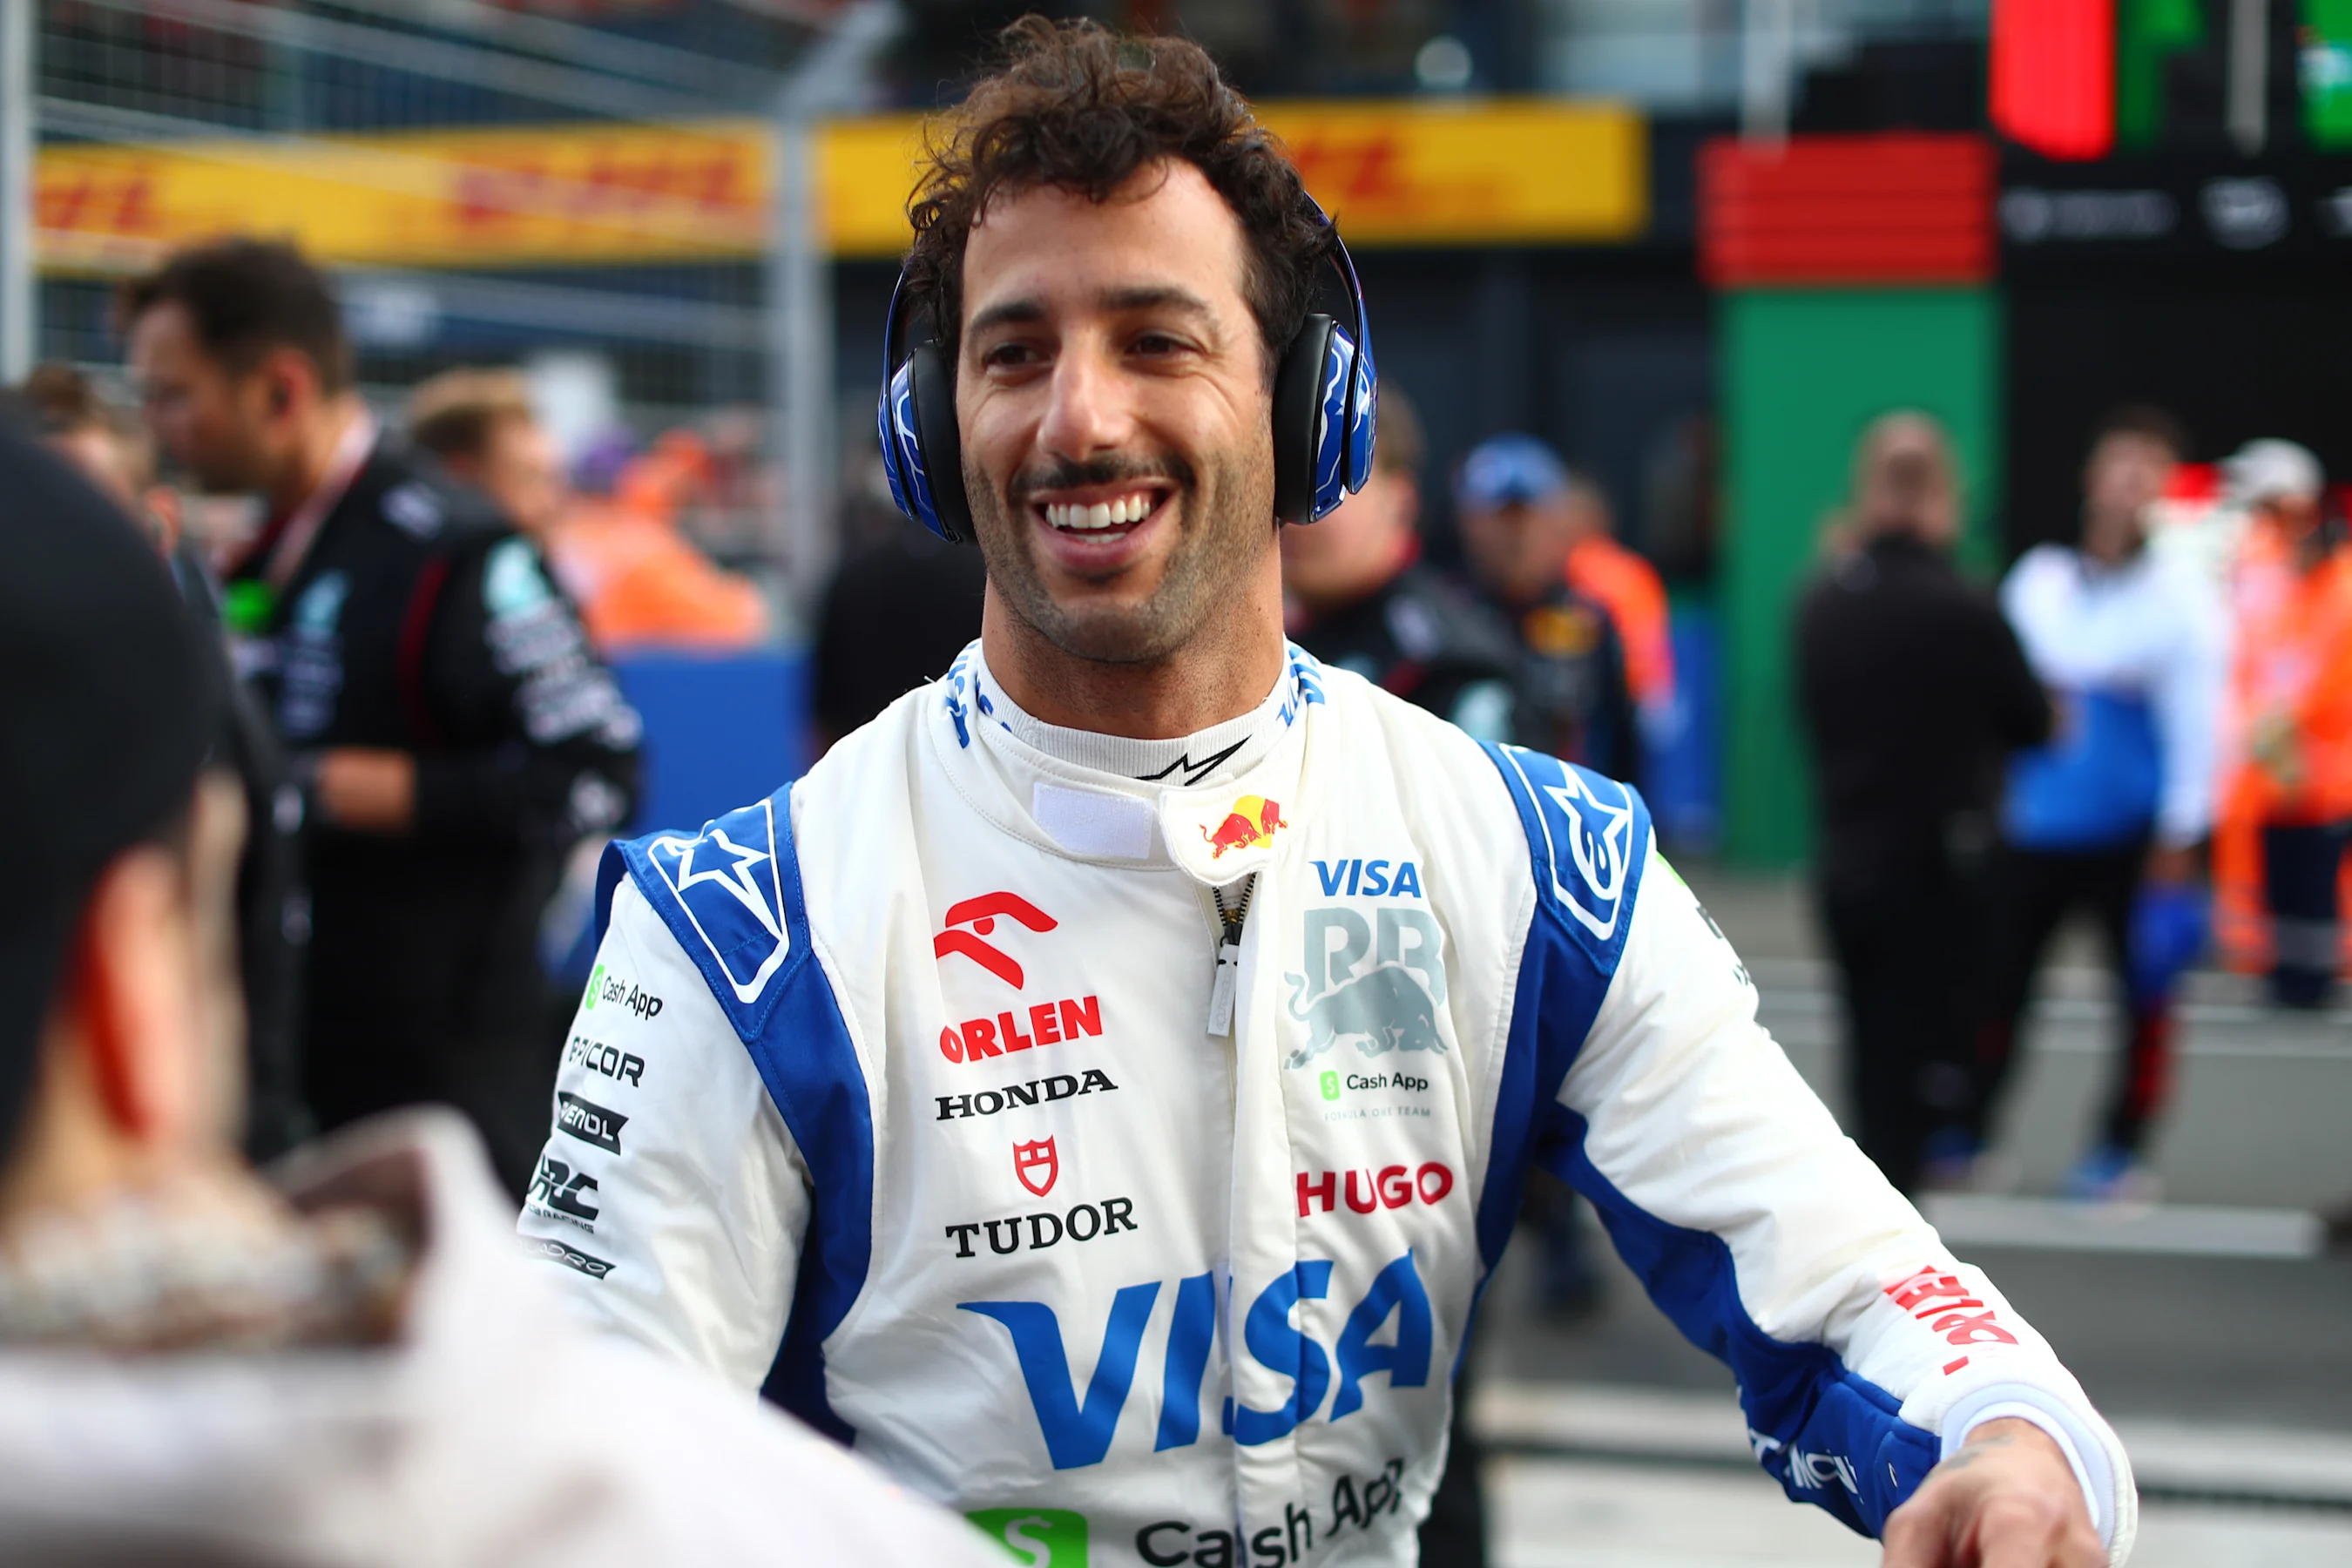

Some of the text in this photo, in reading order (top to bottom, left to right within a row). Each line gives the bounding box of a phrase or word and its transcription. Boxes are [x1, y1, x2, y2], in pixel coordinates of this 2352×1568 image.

[1308, 859, 1422, 898] VISA
[1304, 907, 1446, 1008] RB
[603, 975, 664, 1021] Cash App
[939, 995, 1103, 1064] ORLEN
[935, 1069, 1119, 1120] HONDA
[1347, 1071, 1429, 1092] Cash App
[1397, 1105, 1430, 1118] TEAM
[1296, 1160, 1453, 1218] HUGO
[945, 1197, 1138, 1258] TUDOR
[956, 1247, 1433, 1470] VISA
[1134, 1501, 1312, 1568] Cash
